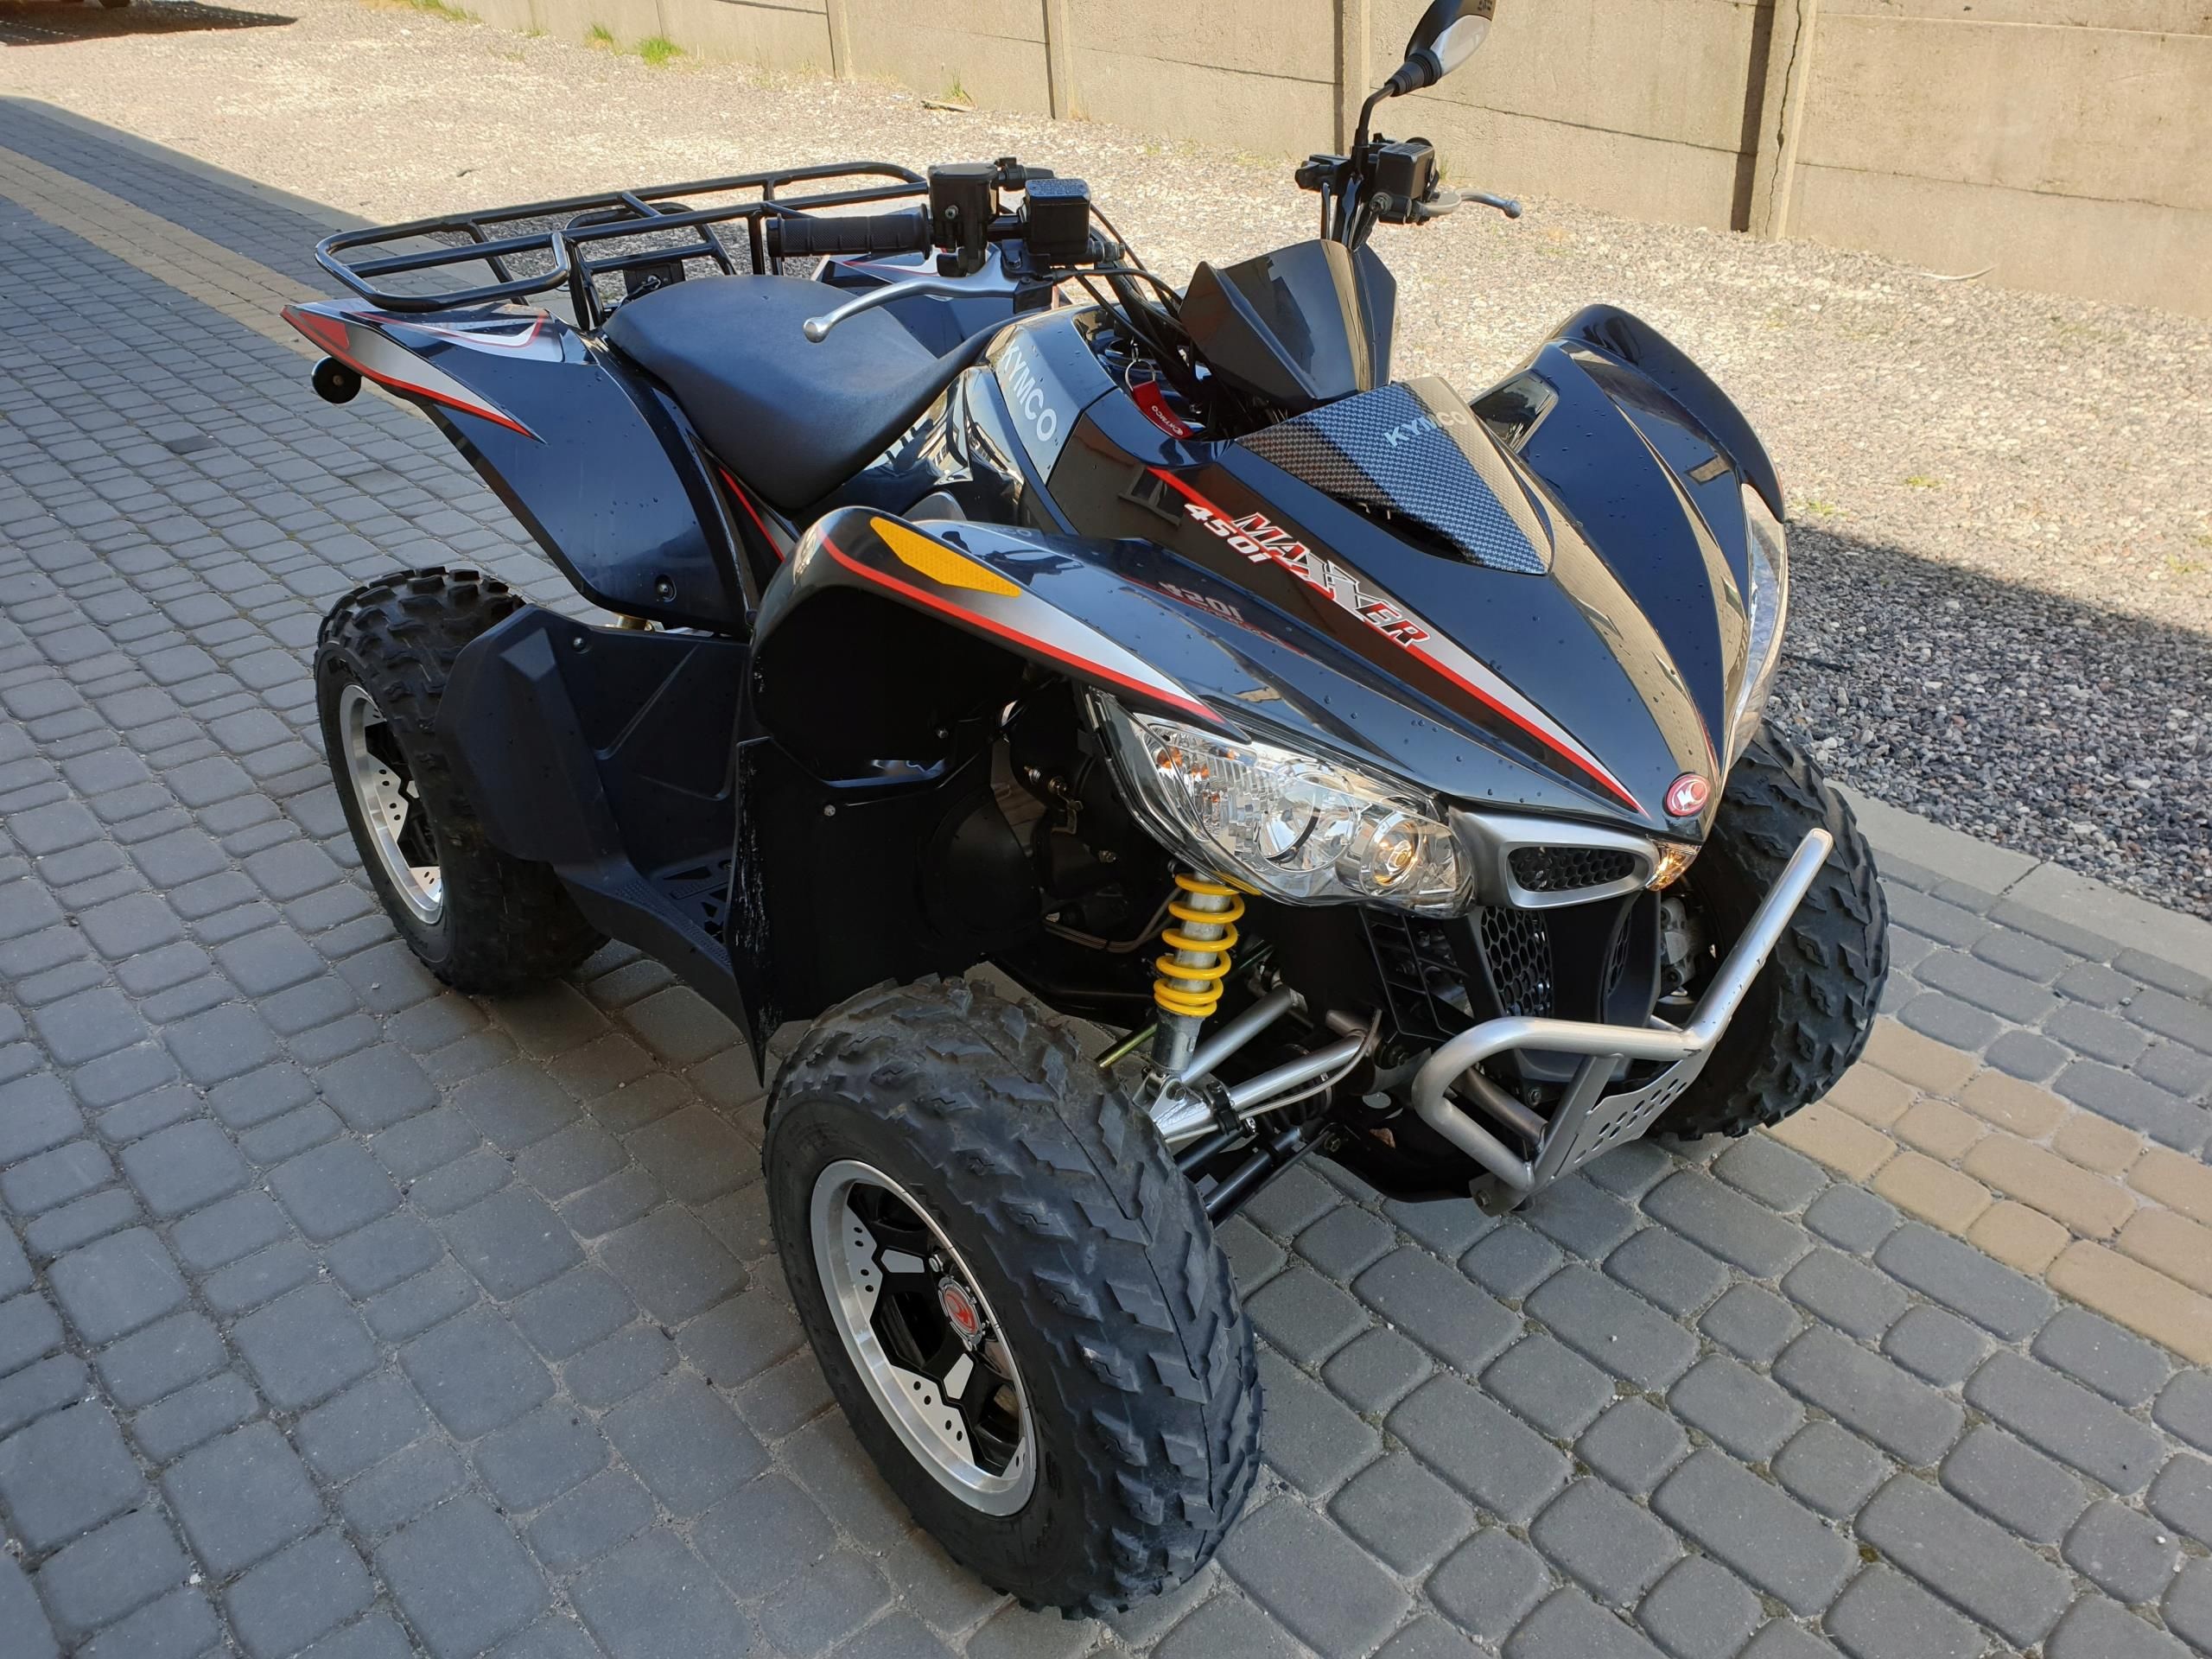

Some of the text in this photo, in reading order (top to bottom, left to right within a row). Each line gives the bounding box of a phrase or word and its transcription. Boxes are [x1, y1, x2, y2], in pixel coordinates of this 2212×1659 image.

[1001, 338, 1057, 442] KYMCO
[1383, 410, 1468, 448] KYMCO
[1184, 502, 1272, 563] 450i
[1230, 512, 1431, 647] MAXXER
